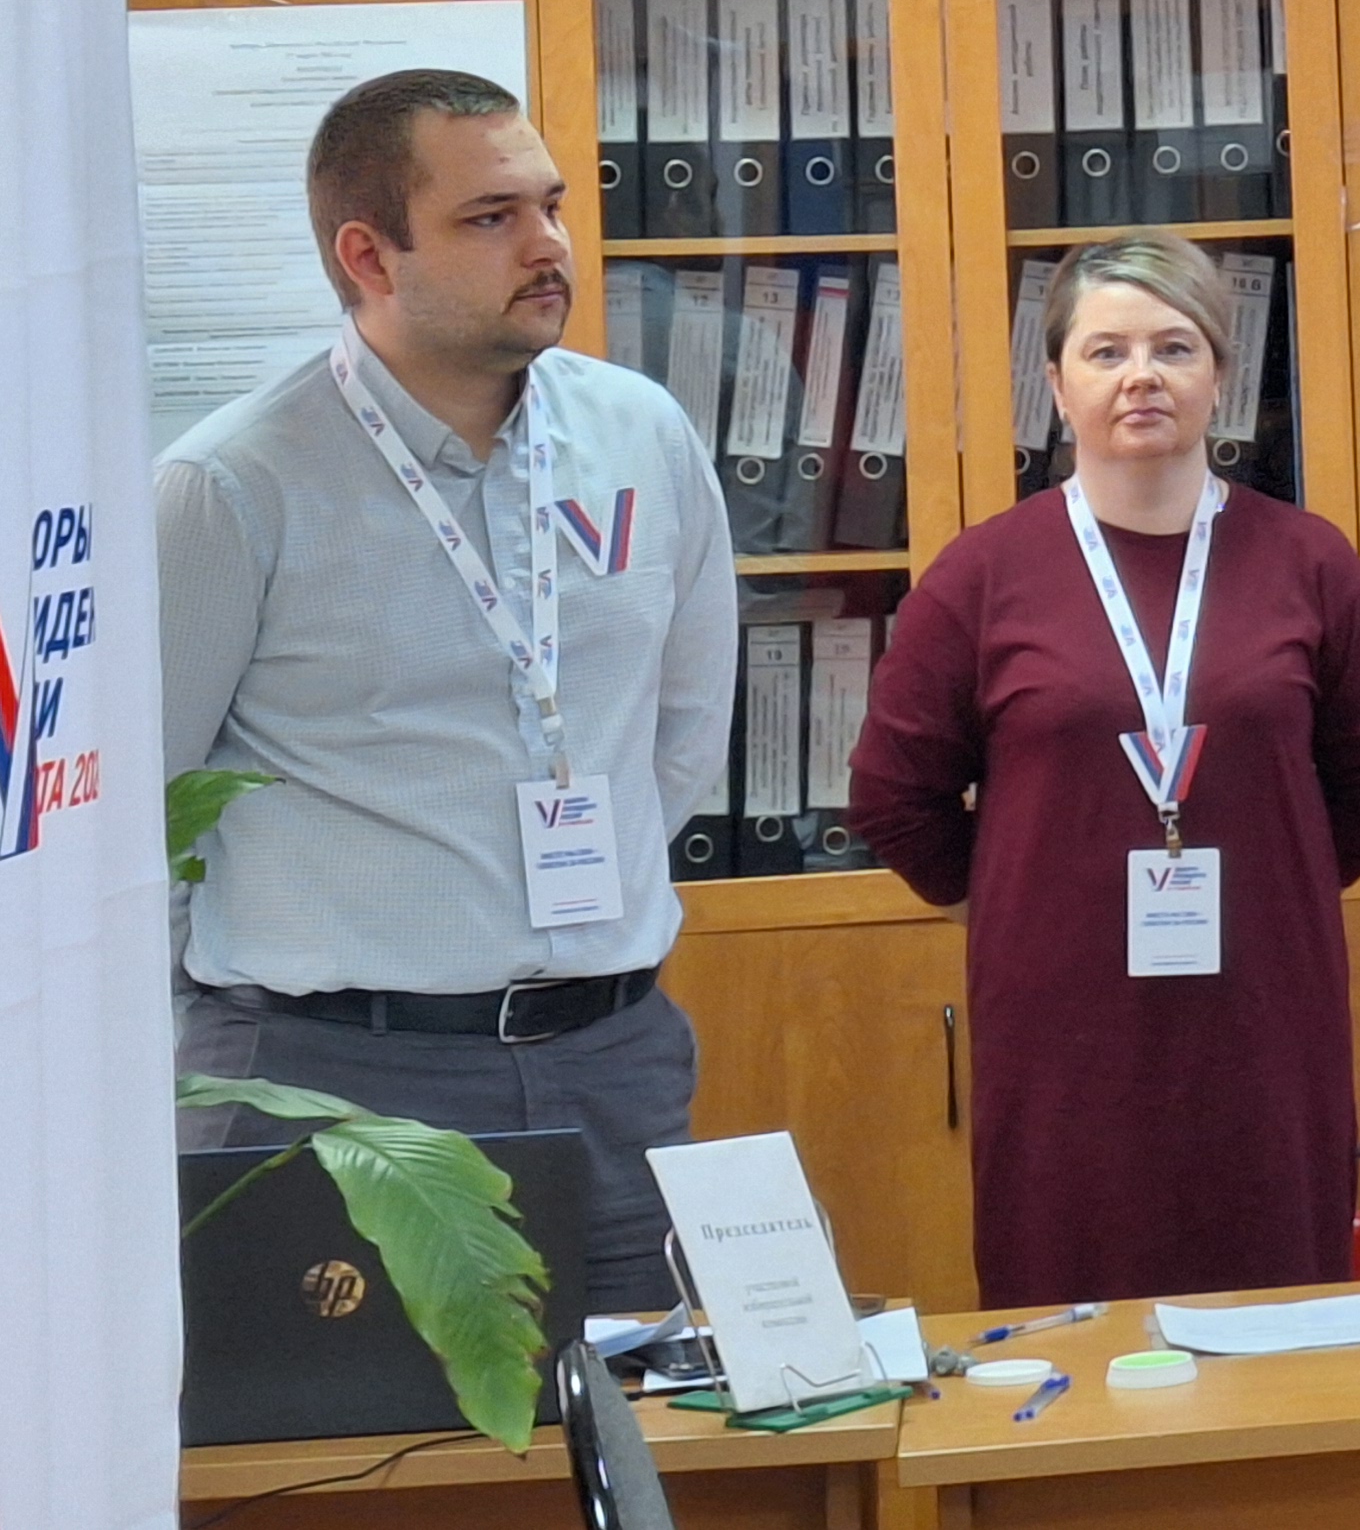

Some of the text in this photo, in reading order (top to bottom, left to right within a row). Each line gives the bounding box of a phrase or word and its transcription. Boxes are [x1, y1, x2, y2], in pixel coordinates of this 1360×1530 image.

[762, 291, 778, 304] 13
[701, 1218, 814, 1243] Председатель
[308, 1259, 360, 1318] hp
